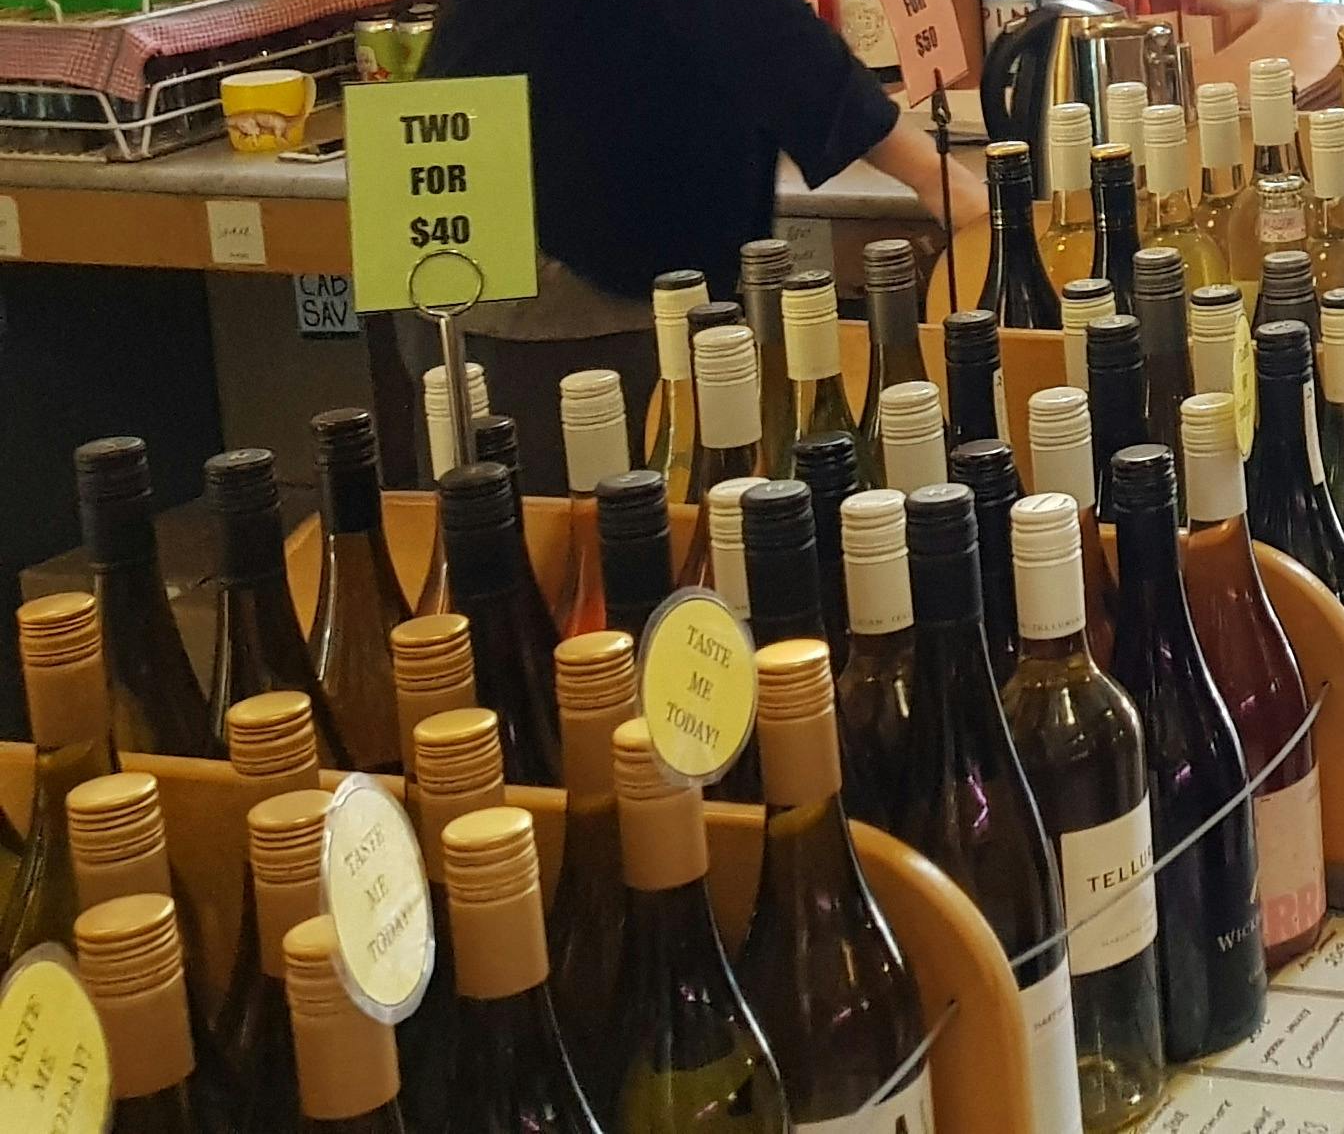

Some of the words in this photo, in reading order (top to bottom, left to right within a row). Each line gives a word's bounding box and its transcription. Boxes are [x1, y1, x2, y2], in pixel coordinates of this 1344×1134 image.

[914, 25, 939, 58] $50
[400, 112, 471, 145] TWO
[410, 164, 468, 196] FOR
[410, 215, 471, 248] $40
[302, 300, 349, 328] SAV
[685, 624, 733, 670] TASTE
[686, 672, 714, 701] ME
[664, 701, 720, 750] TODAY!
[343, 822, 387, 877] TASTE
[364, 874, 390, 907] ME
[29, 1048, 57, 1101] ME
